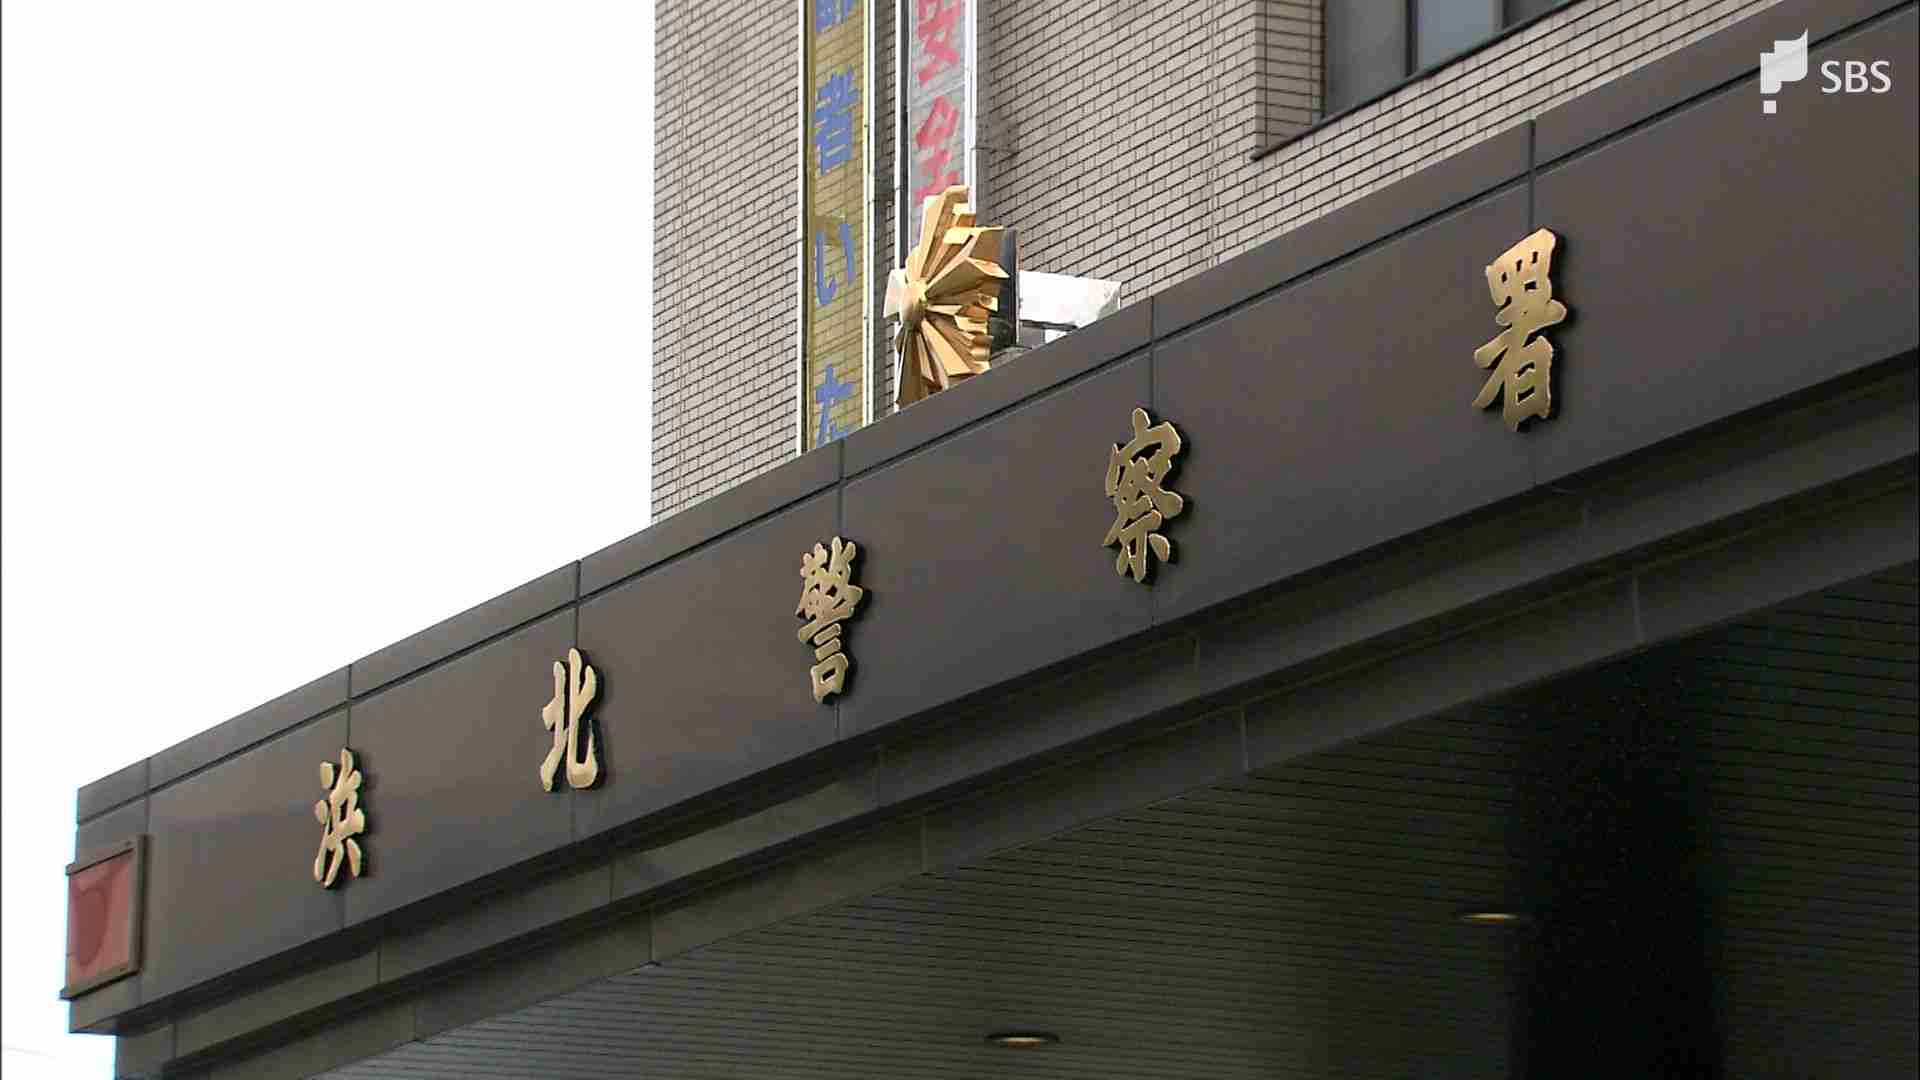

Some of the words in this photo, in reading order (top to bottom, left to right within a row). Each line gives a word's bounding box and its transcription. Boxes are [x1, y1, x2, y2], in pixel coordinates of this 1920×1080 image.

[314, 228, 1568, 889] 浜北警察署
